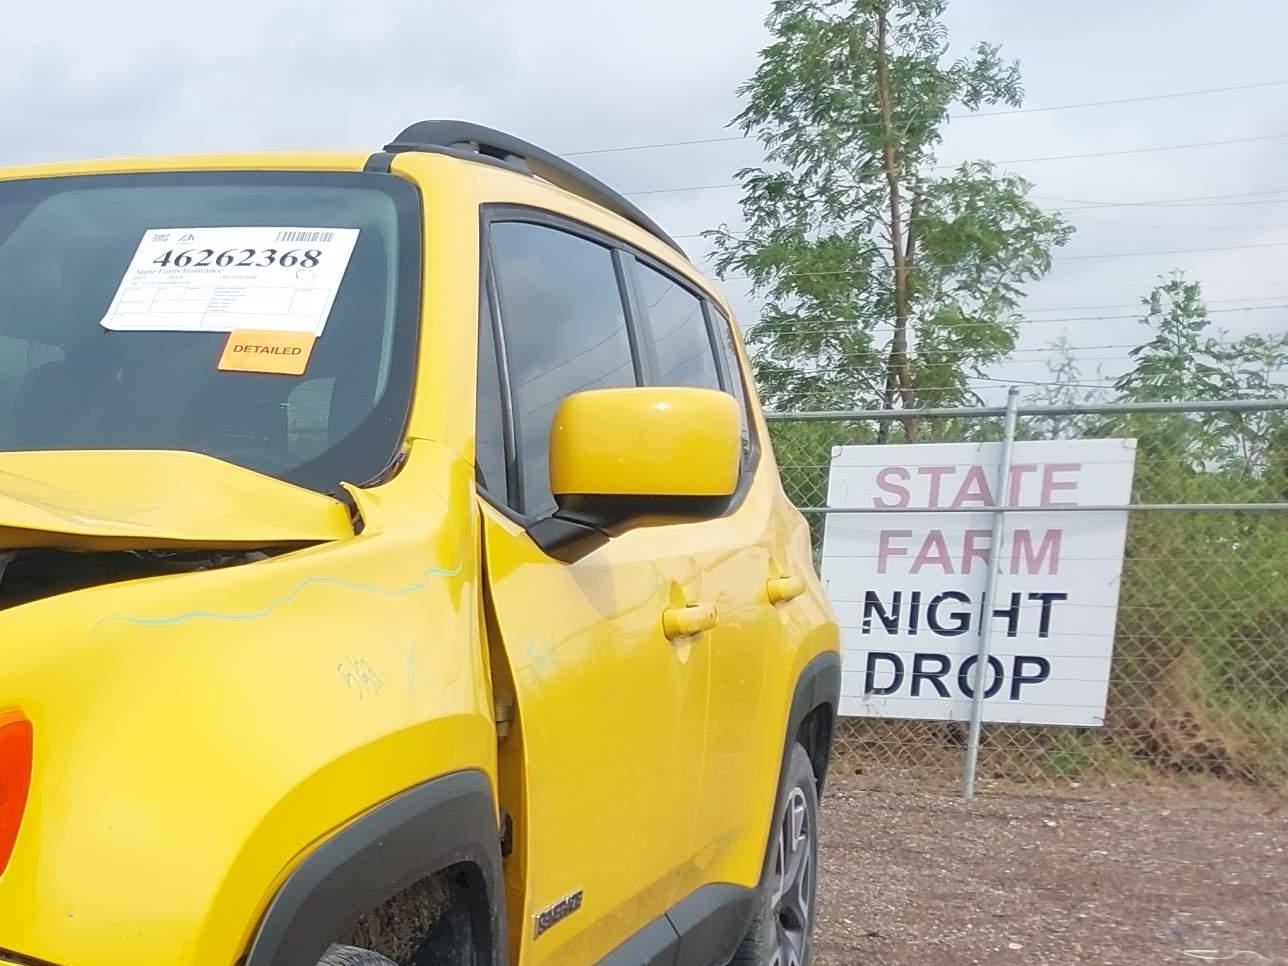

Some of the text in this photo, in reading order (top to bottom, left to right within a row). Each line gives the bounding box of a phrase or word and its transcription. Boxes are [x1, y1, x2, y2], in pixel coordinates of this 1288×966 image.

[152, 248, 323, 268] 46262368
[232, 344, 303, 356] DETAILED
[871, 462, 1082, 509] STATE
[874, 528, 1065, 576] FARM
[861, 590, 1068, 639] NIGHT
[863, 651, 1052, 701] DROP
